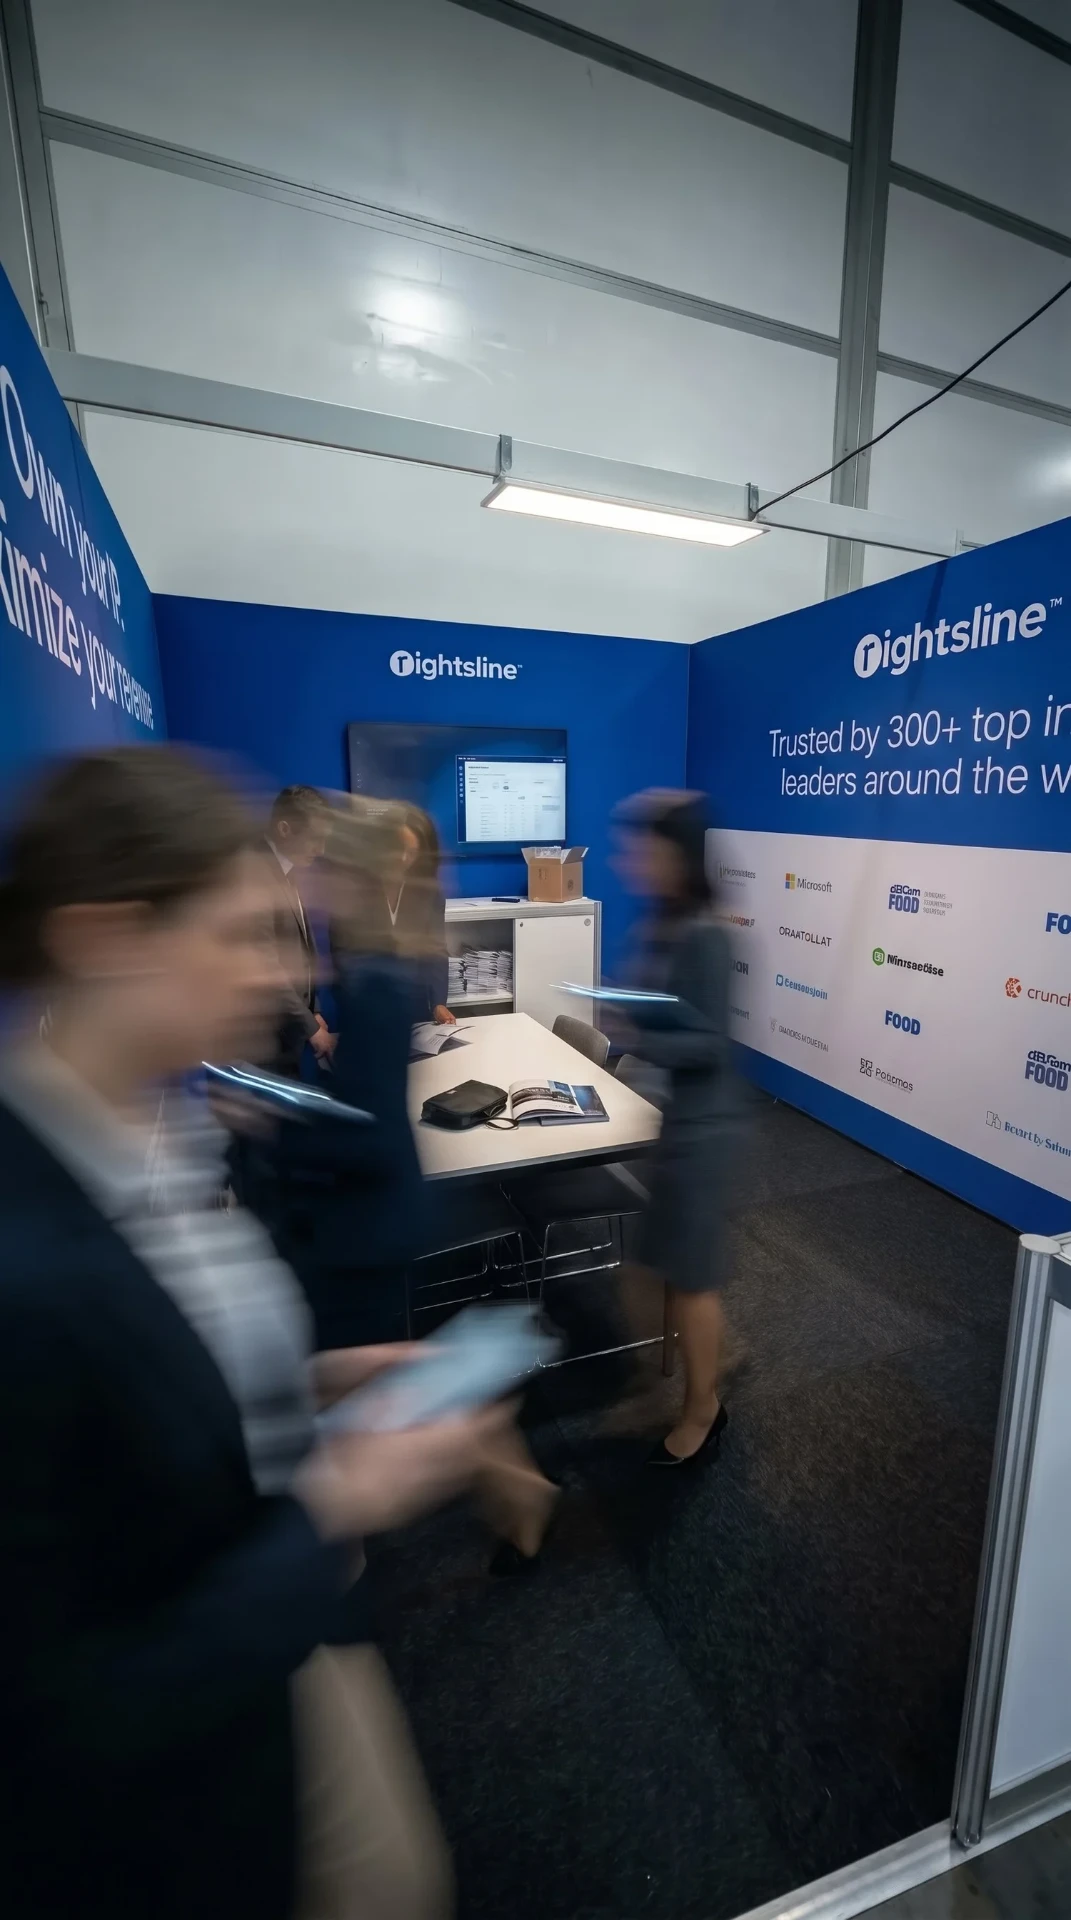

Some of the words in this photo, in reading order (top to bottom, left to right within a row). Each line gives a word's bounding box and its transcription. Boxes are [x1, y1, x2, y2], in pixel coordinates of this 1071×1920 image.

[70, 506, 109, 610] your
[80, 621, 118, 710] your
[769, 721, 844, 757] Trusted
[850, 720, 880, 758] by
[887, 710, 961, 748] 300+
[972, 706, 1031, 750] top
[781, 766, 857, 796] leaders
[864, 757, 963, 795] around
[972, 756, 1029, 794] the
[797, 878, 832, 893] Microsoft
[888, 894, 920, 914] FOOD
[885, 1010, 921, 1036] FOOD
[1024, 1060, 1069, 1092] FOOD
